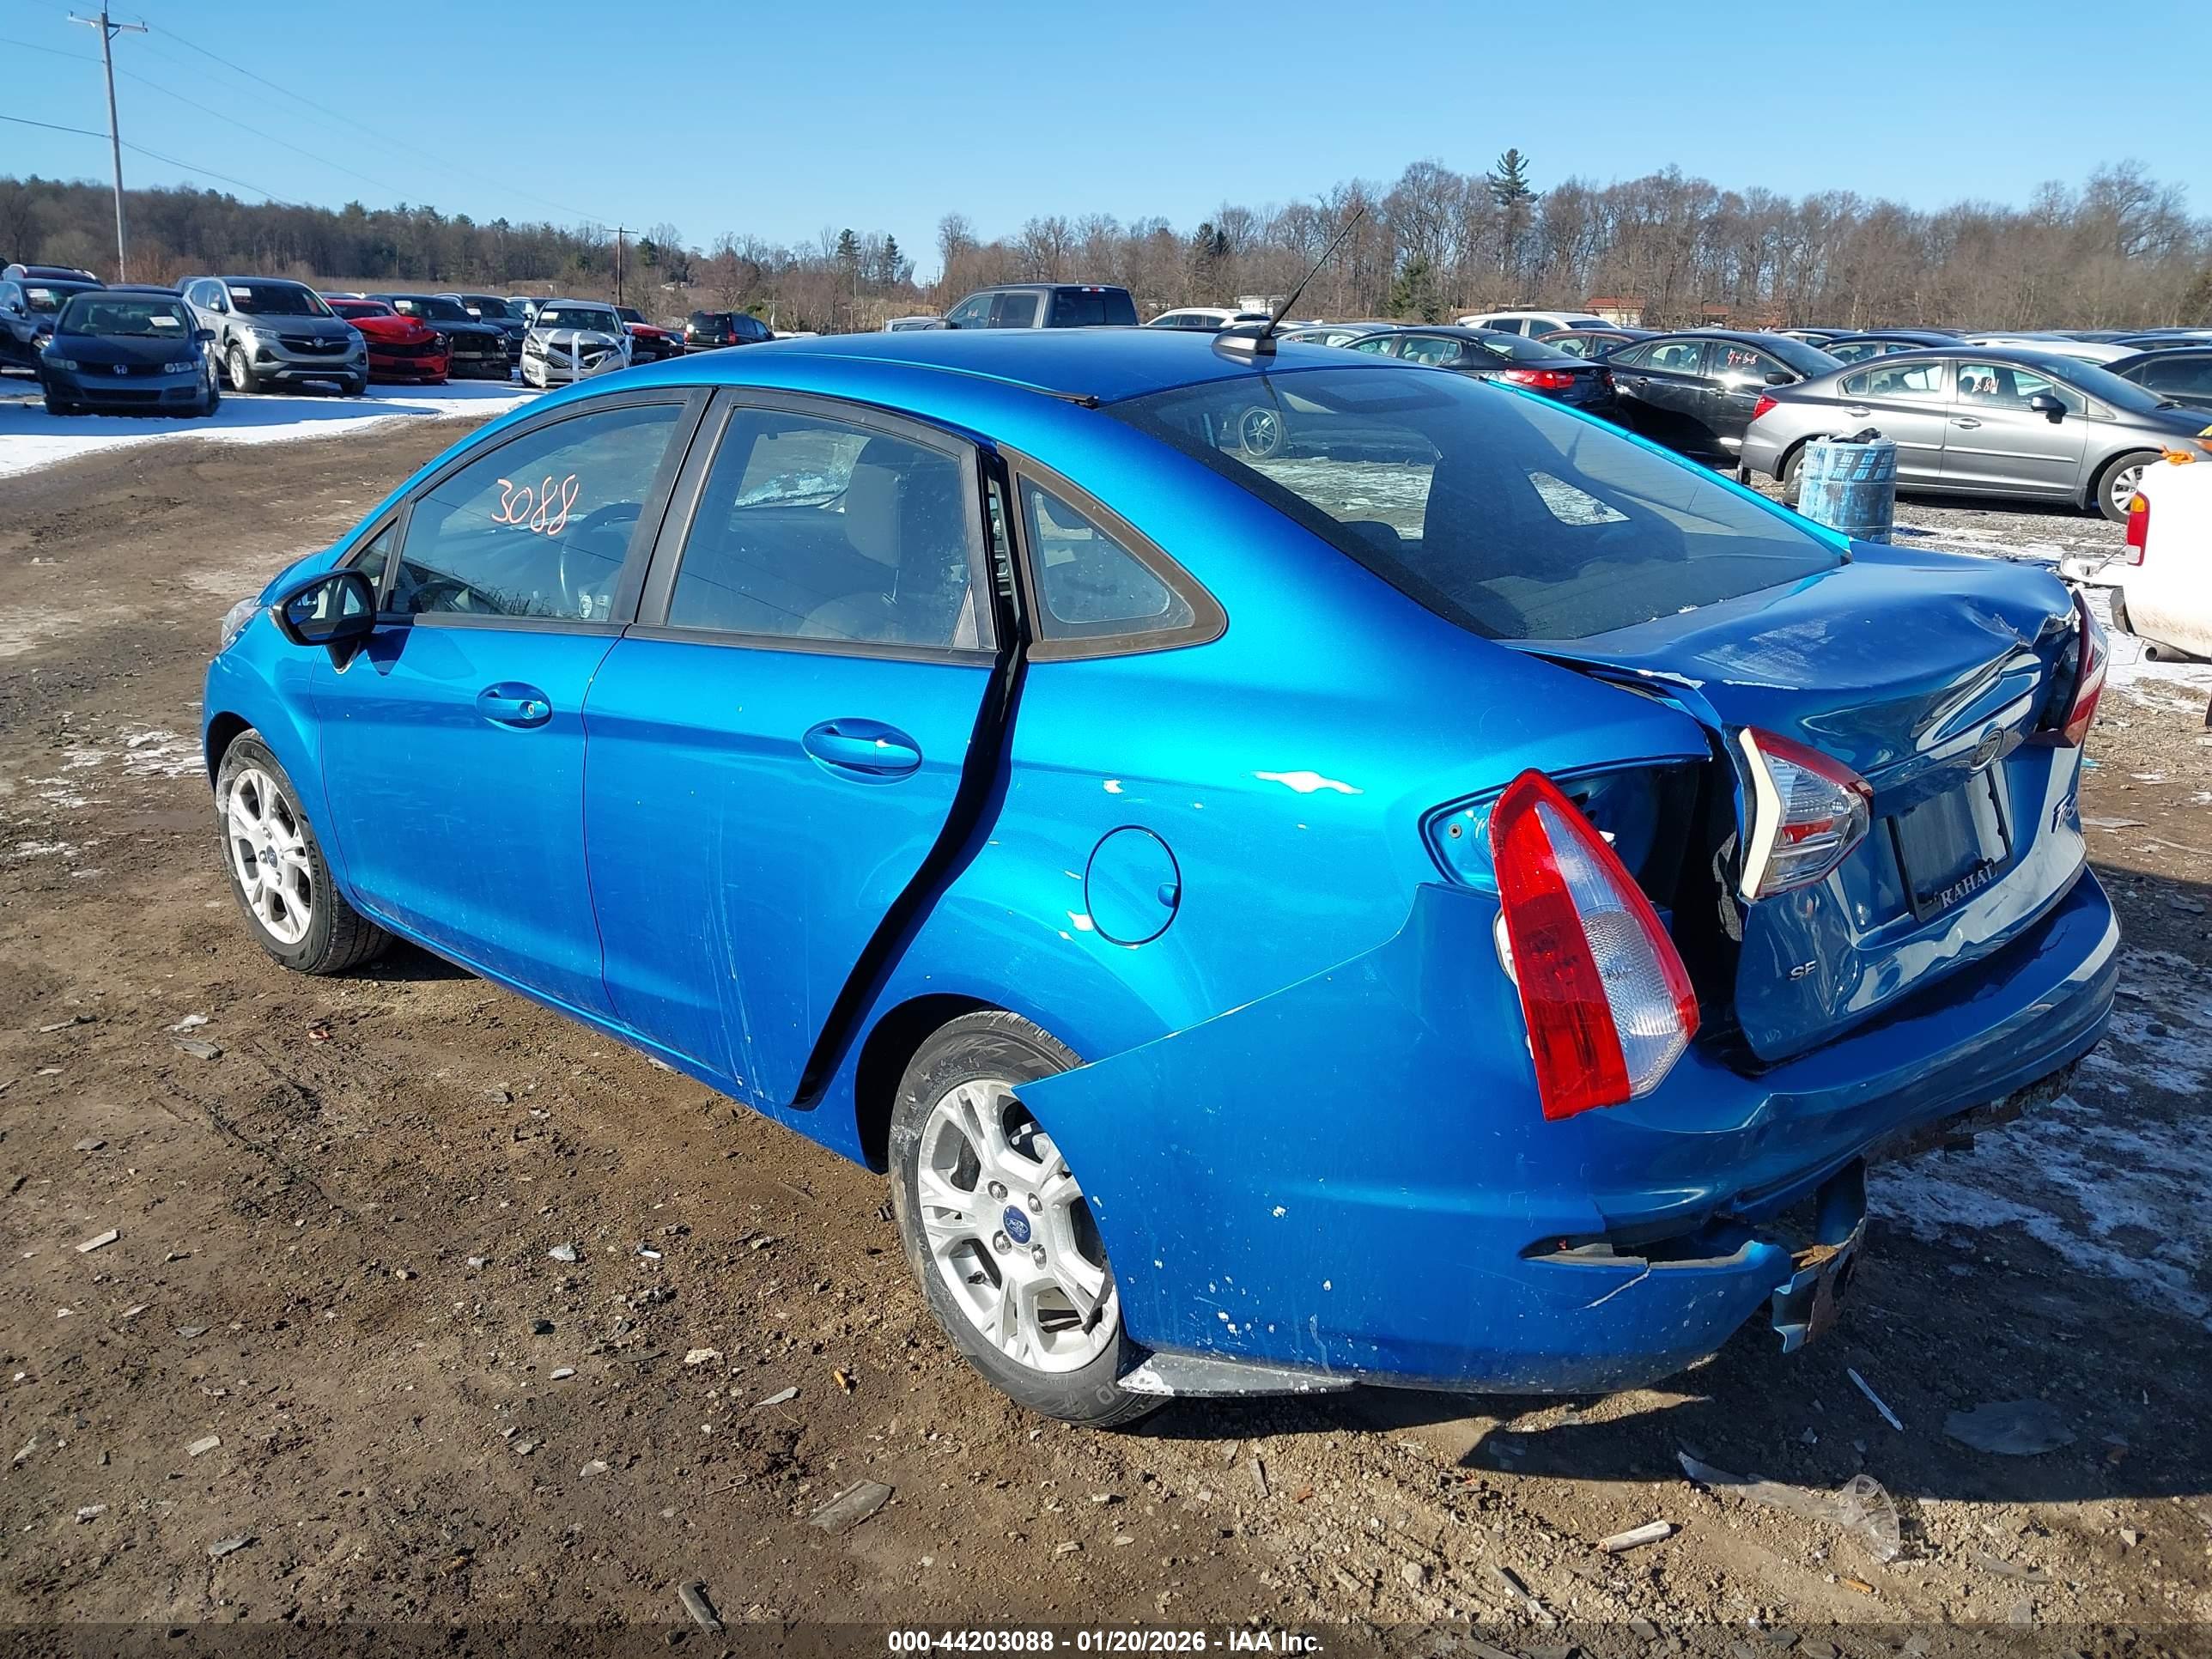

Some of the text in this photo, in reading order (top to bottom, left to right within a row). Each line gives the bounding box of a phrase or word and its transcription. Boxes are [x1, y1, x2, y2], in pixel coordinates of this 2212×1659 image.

[491, 474, 580, 536] 3088
[1939, 862, 1998, 909] RAHAL
[1790, 960, 1817, 981] SE
